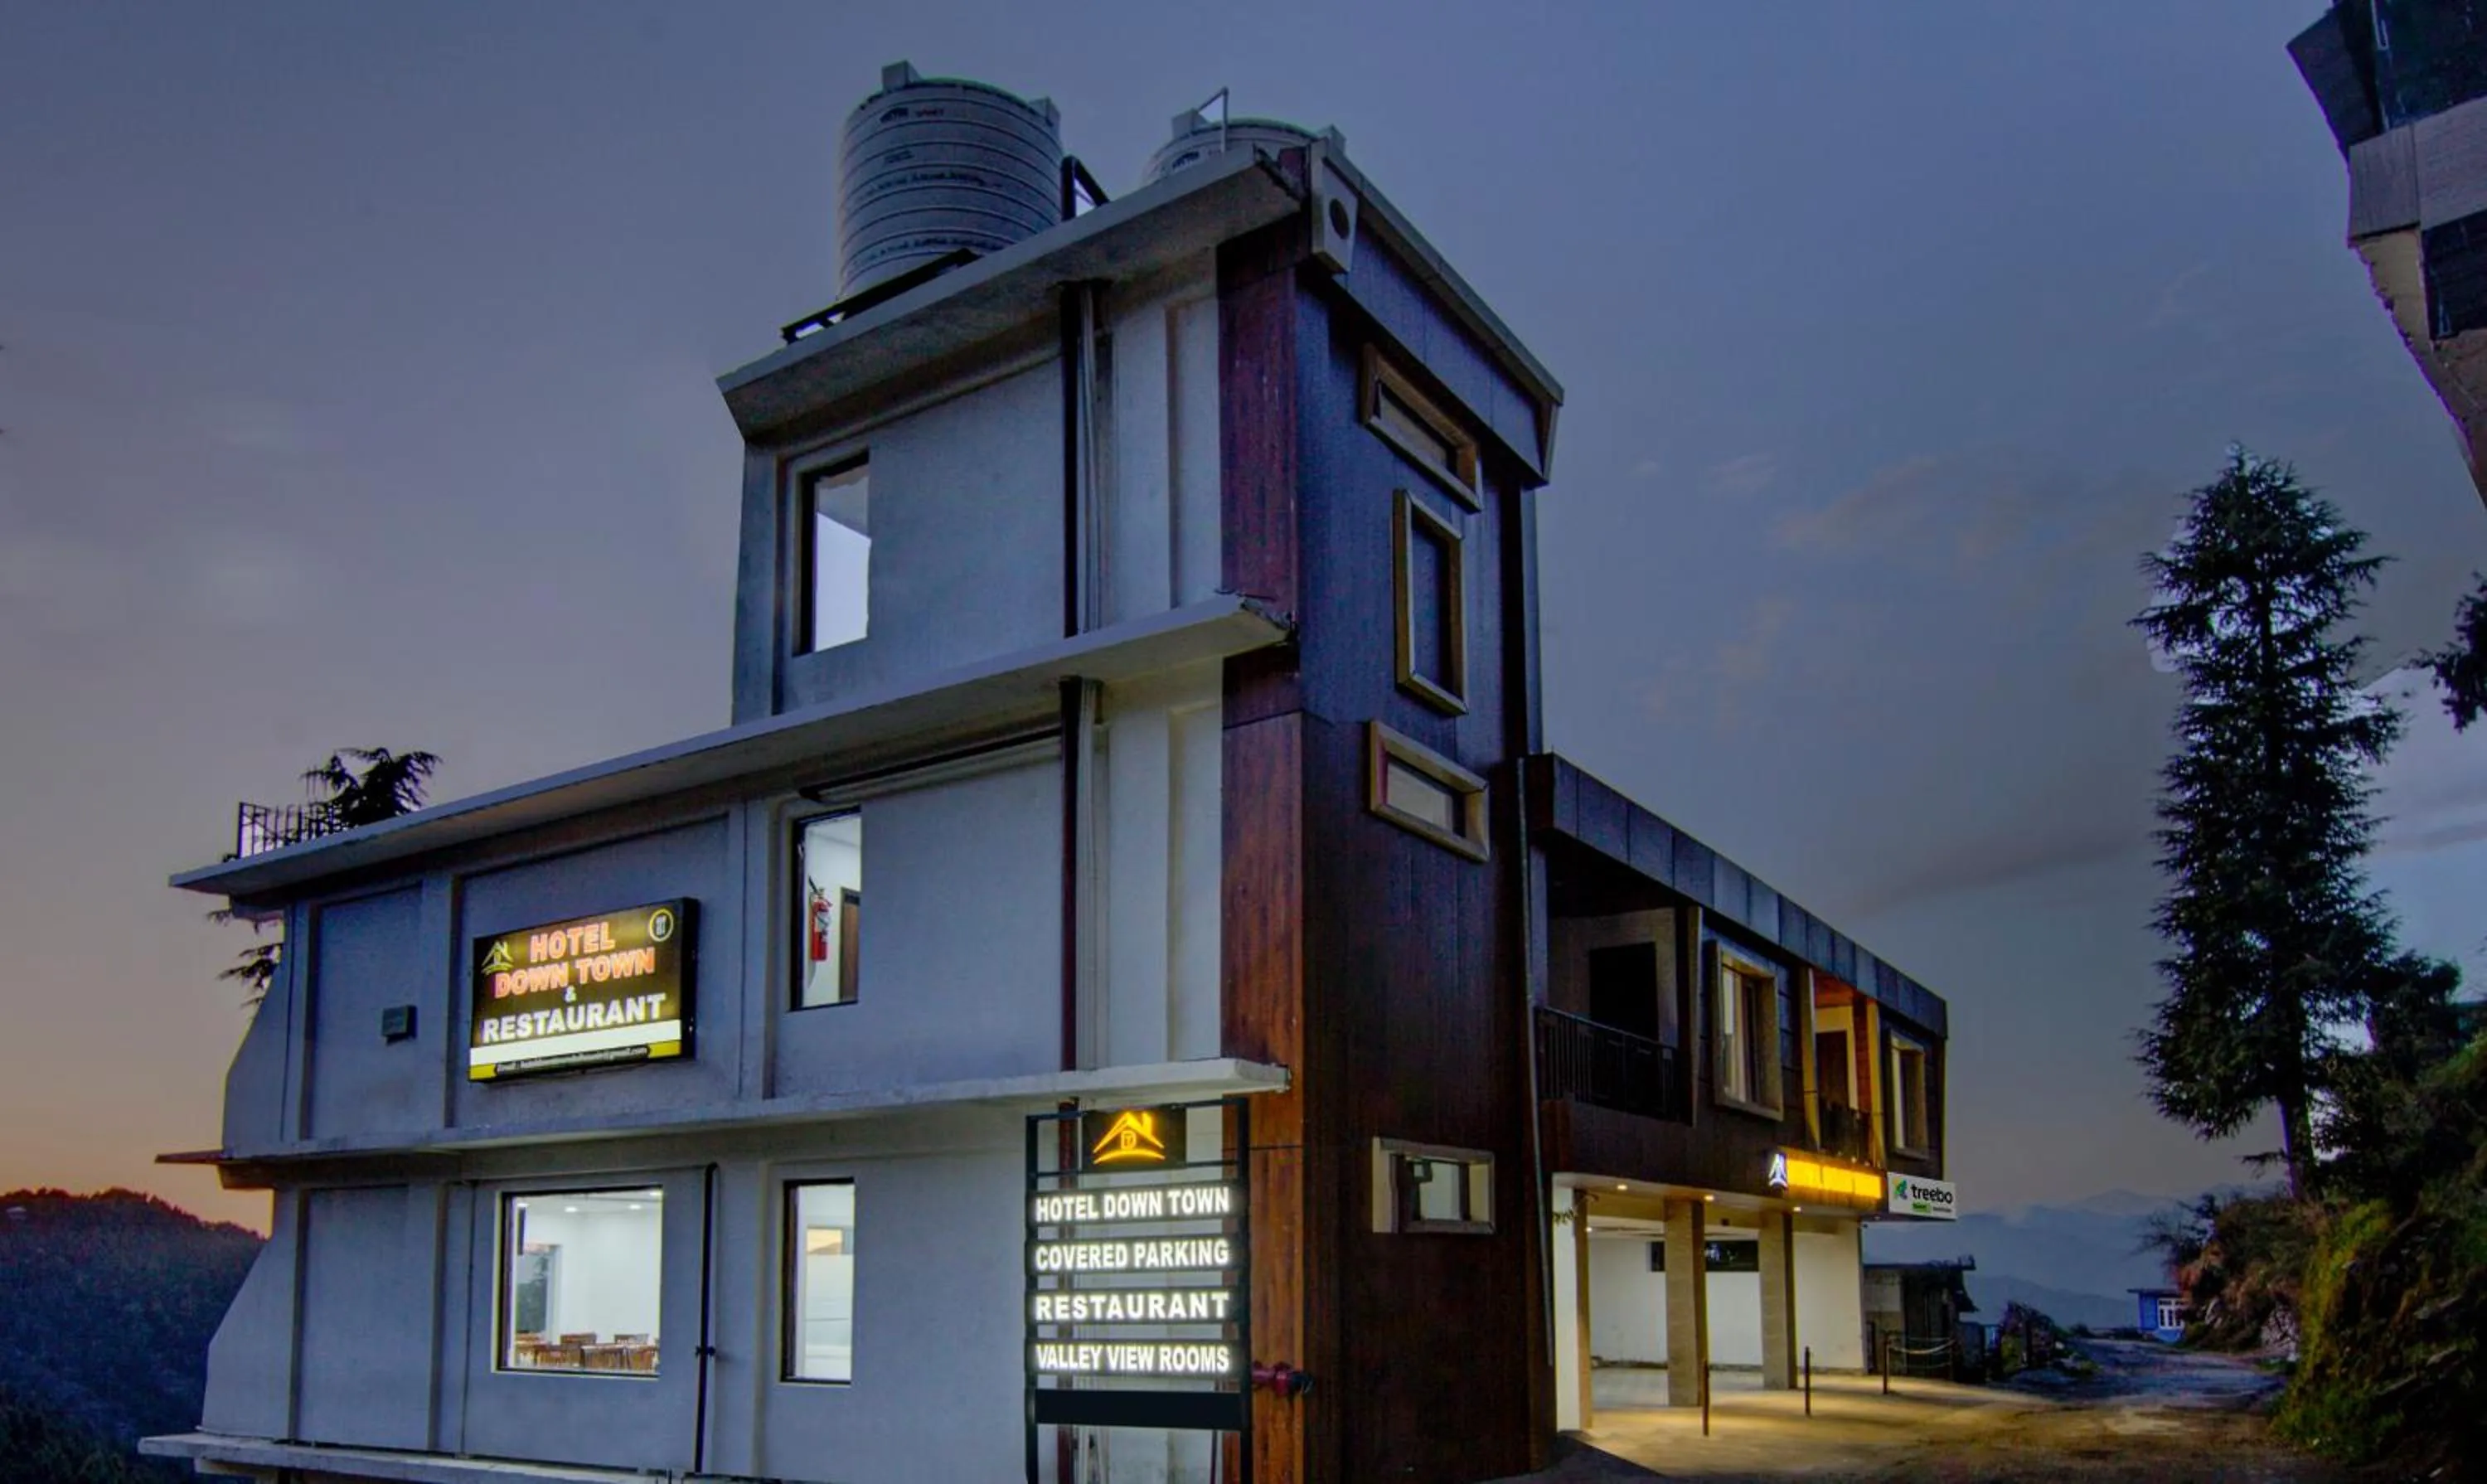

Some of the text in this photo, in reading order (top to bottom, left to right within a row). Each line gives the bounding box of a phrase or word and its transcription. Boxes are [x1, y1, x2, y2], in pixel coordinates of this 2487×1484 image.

[530, 921, 616, 963] HOTEL
[494, 946, 656, 999] DOWN TOWN
[564, 986, 577, 1002] &
[481, 992, 667, 1043] RESTAURANT
[1036, 1186, 1230, 1222] HOTEL DOWN TOWN
[1911, 1184, 1953, 1204] treebo
[1036, 1239, 1229, 1271] COVERED PARKING
[1036, 1292, 1230, 1321] RESTAURANT
[1036, 1344, 1230, 1373] VALLEY VIEW ROOMS
